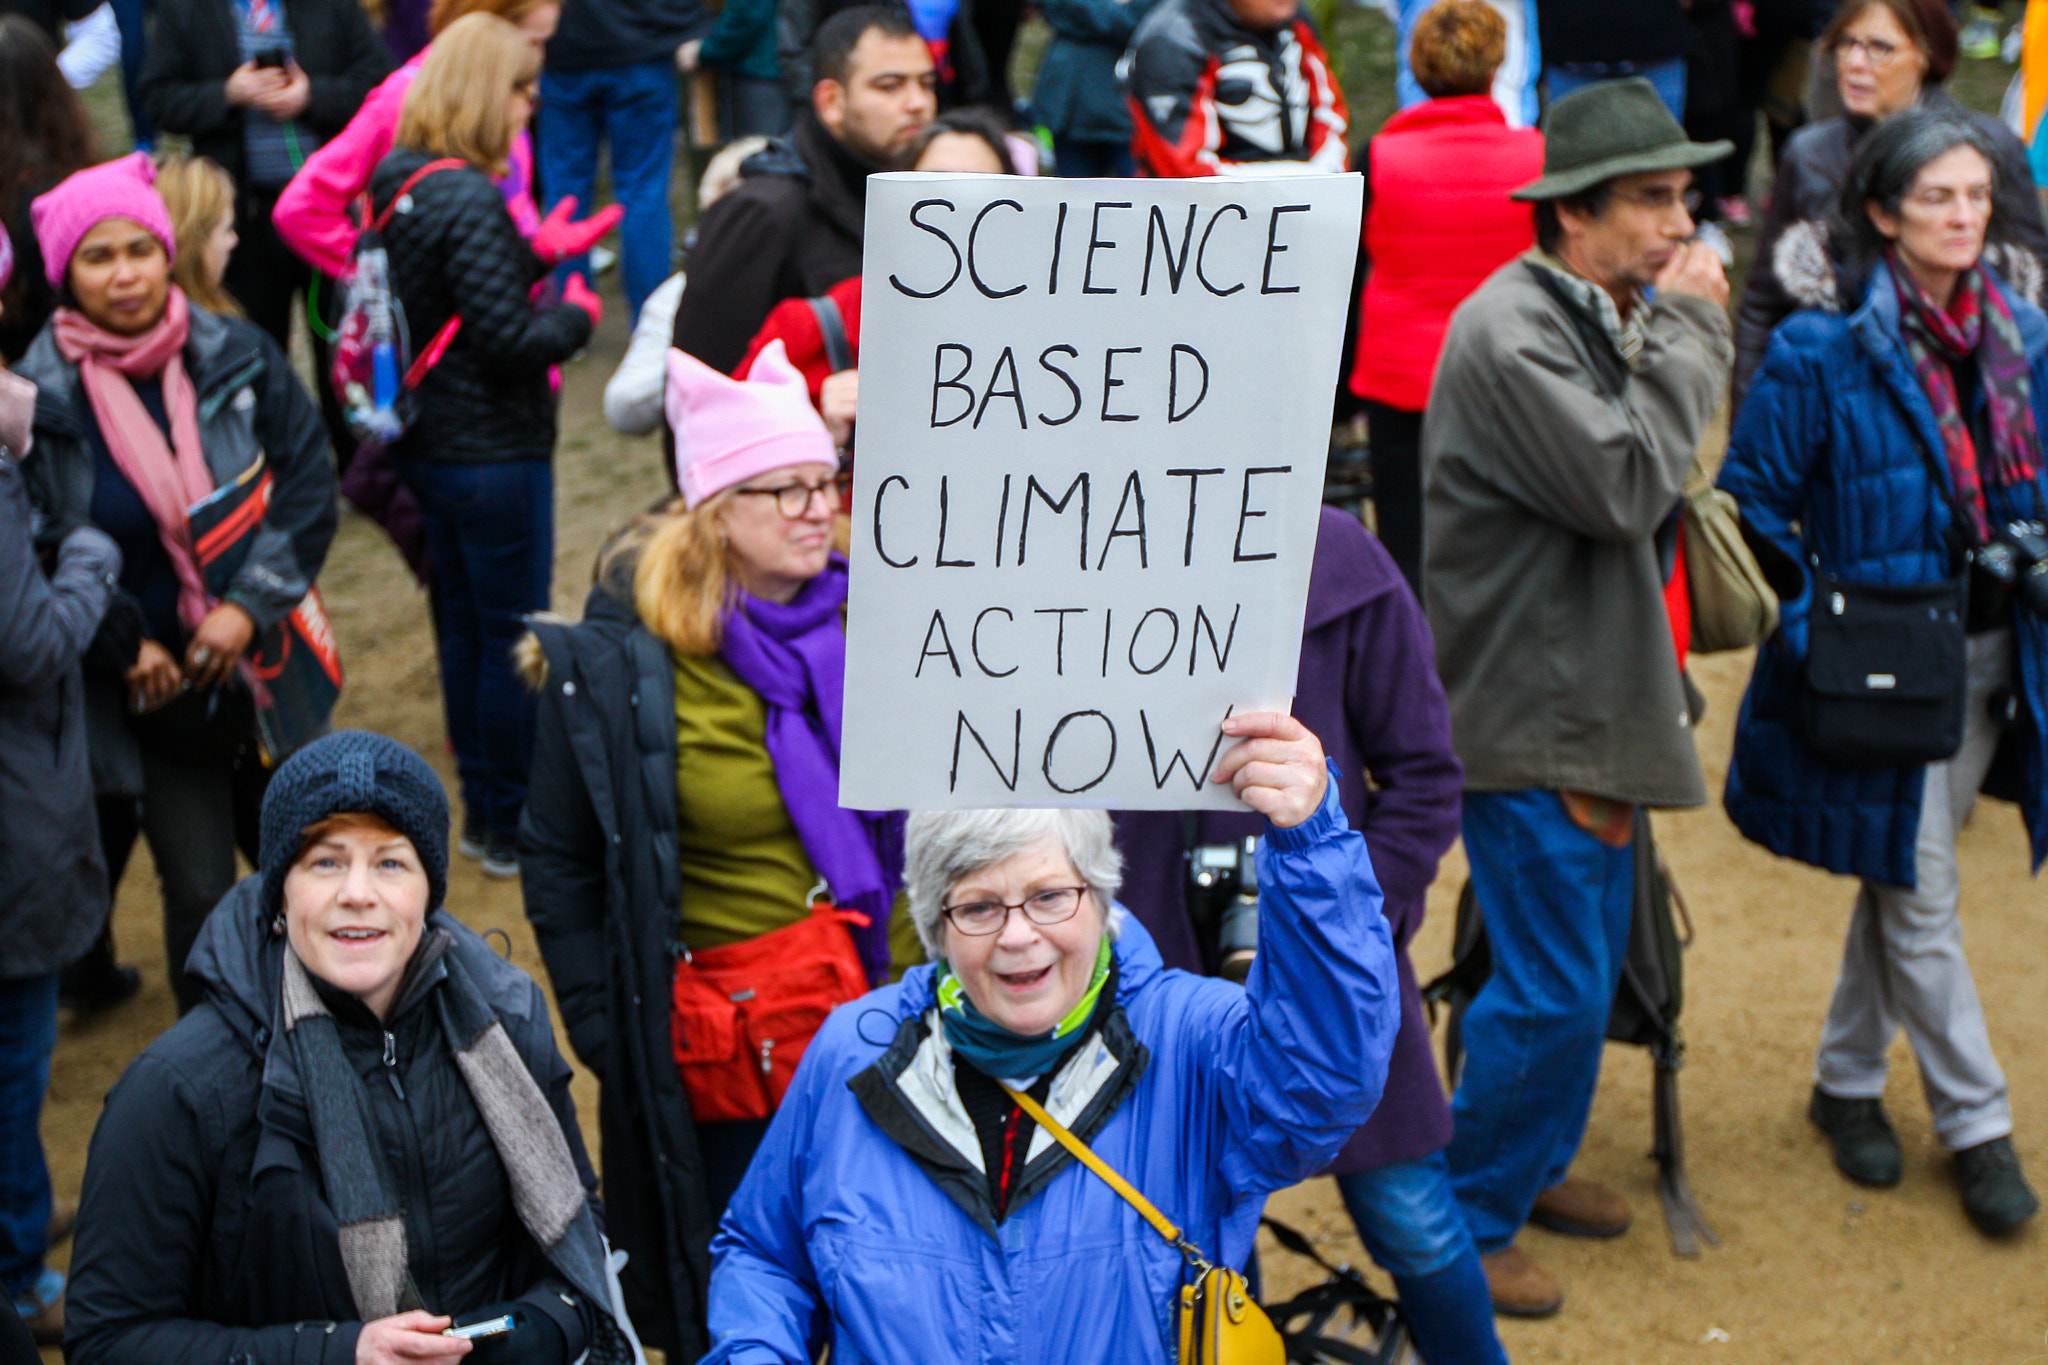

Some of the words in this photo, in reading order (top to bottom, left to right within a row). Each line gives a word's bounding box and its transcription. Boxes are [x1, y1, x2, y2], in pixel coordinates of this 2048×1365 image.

[888, 198, 1311, 299] SCIENCE
[930, 343, 1209, 430] BASED
[873, 465, 1292, 571] CLIMATE
[914, 603, 1241, 678] ACTION
[950, 704, 1234, 794] NOW
